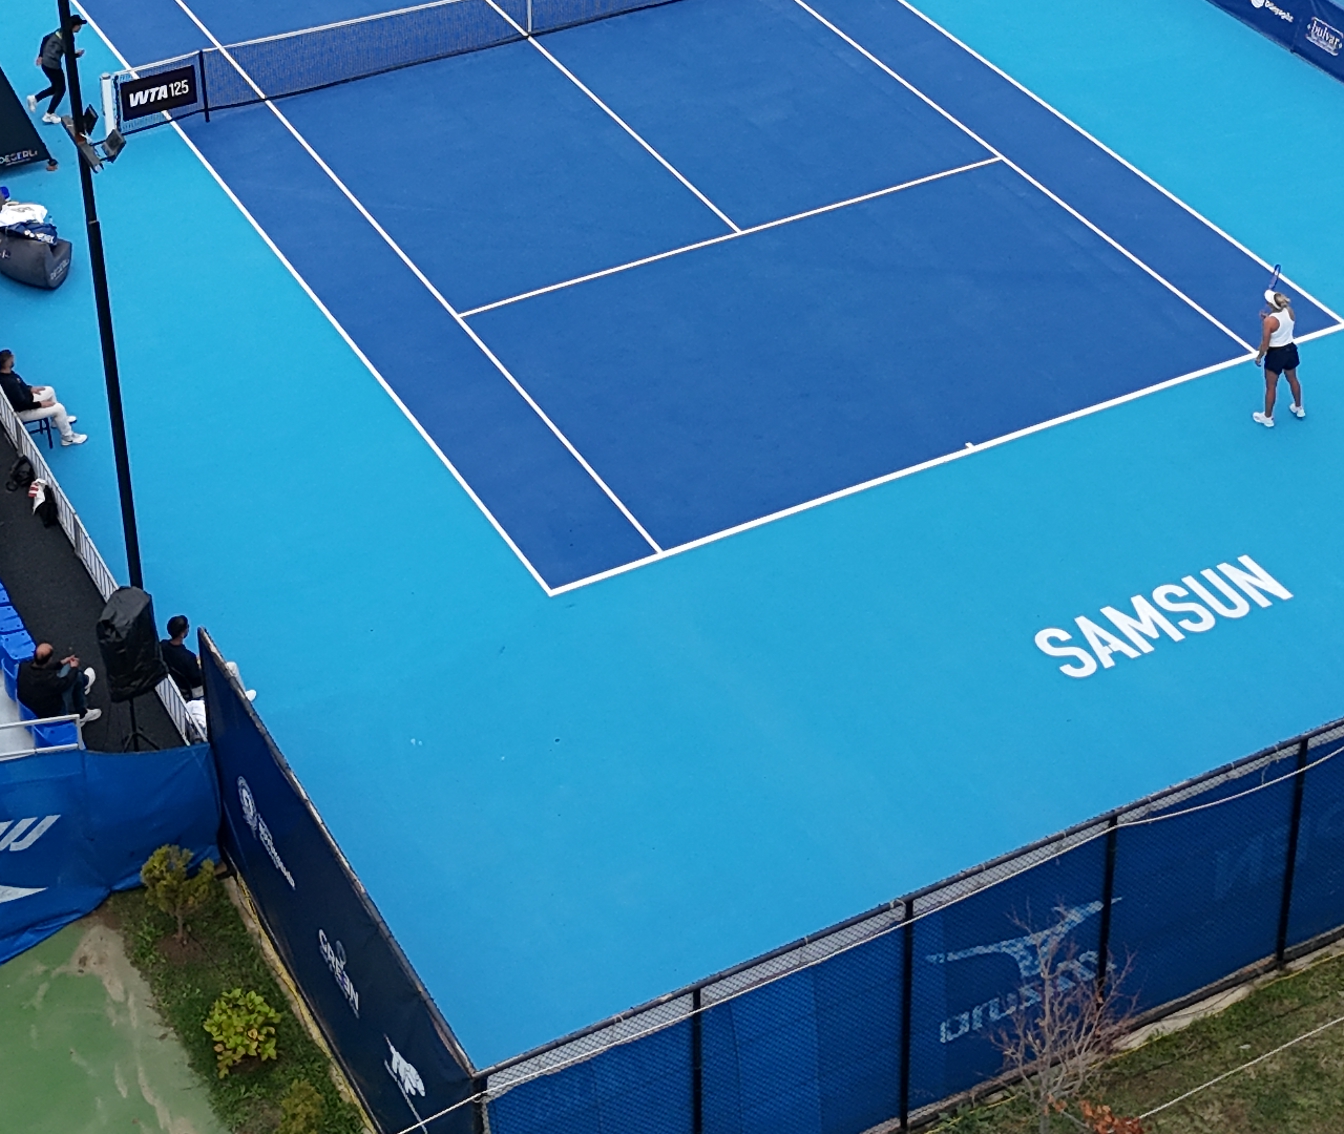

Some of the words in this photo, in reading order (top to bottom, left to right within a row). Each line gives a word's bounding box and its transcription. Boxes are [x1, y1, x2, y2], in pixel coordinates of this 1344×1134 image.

[129, 85, 169, 108] WTA
[167, 79, 189, 99] 125
[1034, 554, 1294, 679] SAMSUN
